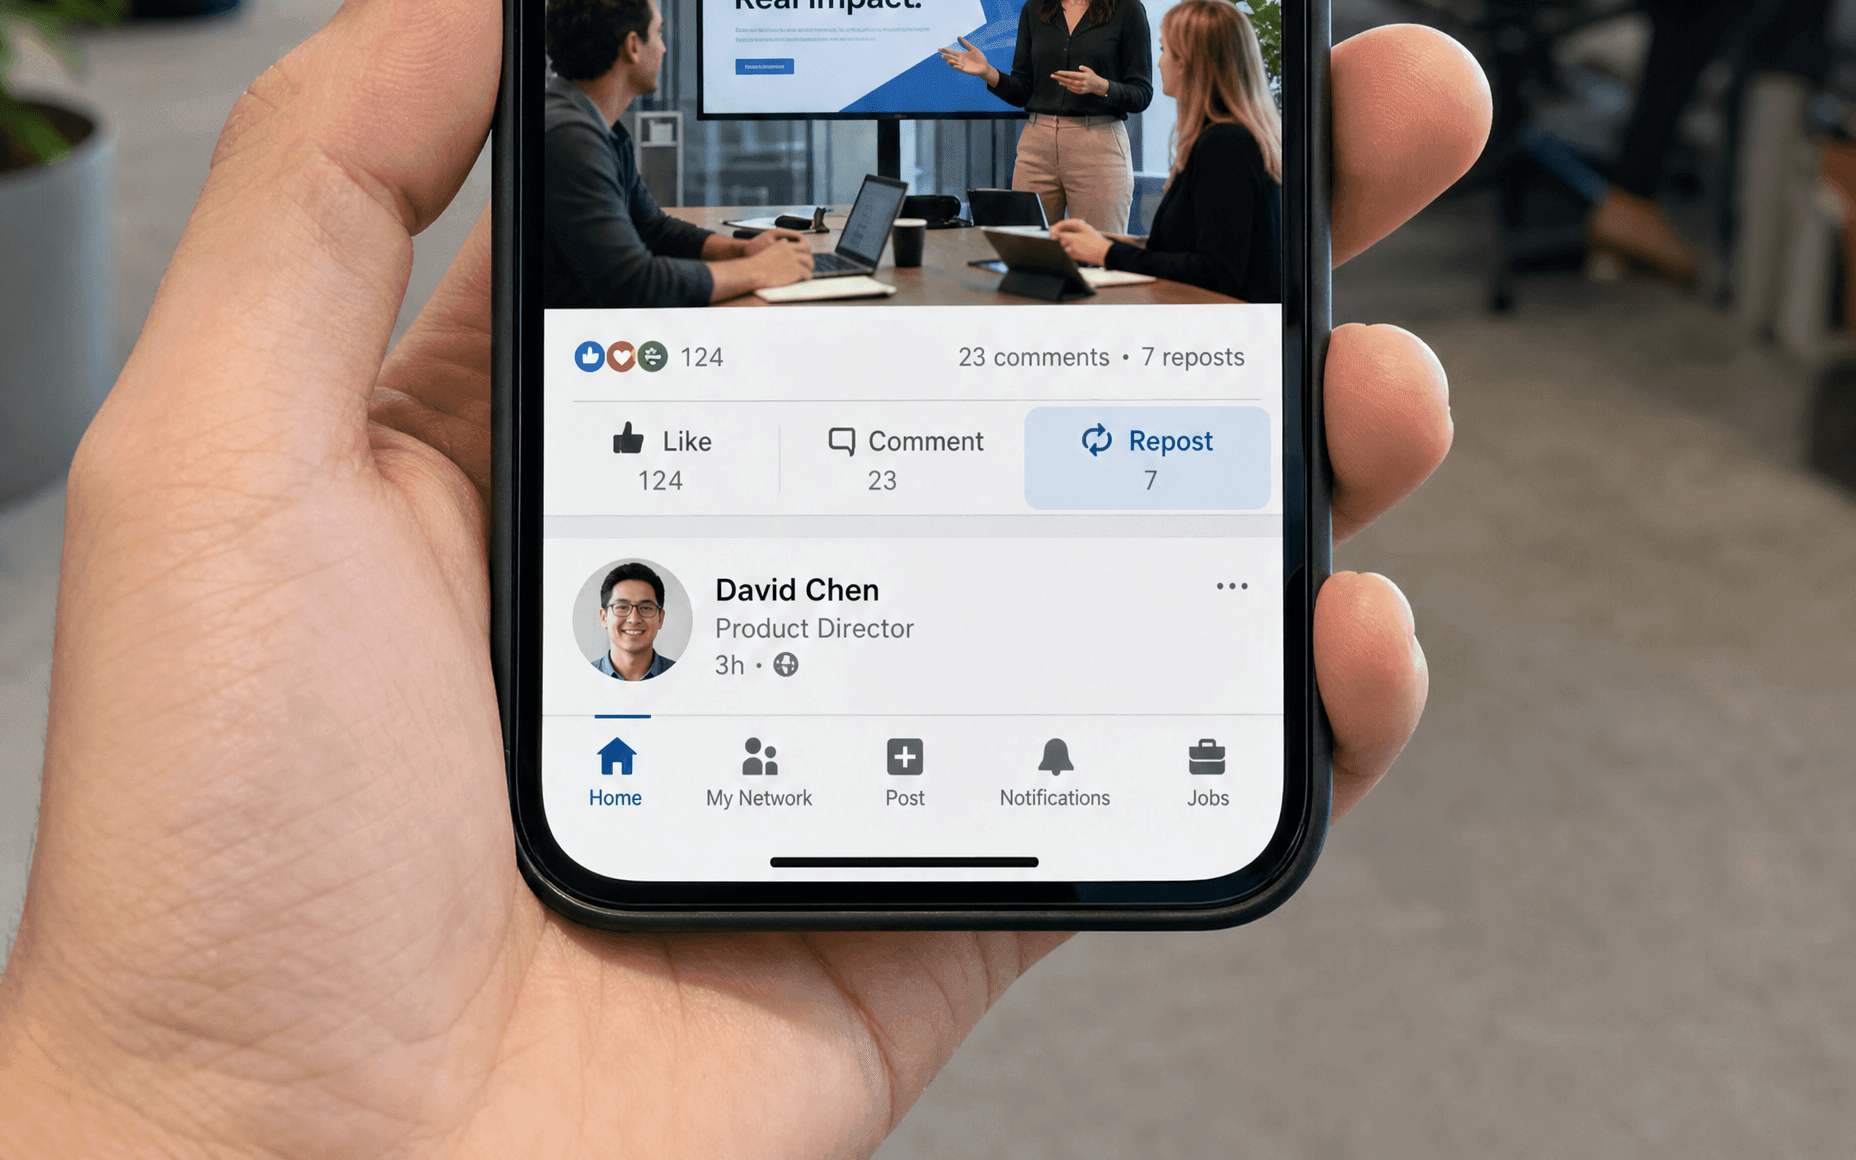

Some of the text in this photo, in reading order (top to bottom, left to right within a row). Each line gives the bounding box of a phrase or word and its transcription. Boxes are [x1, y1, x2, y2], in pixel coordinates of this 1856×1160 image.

[681, 346, 724, 367] 124
[959, 346, 1245, 372] 23 comments 7 reposts
[664, 429, 712, 452] Like
[868, 429, 985, 452] Comment
[1130, 429, 1214, 458] Repost
[638, 469, 684, 491] 124
[868, 469, 897, 491] 23
[1144, 469, 1158, 491] 7
[716, 577, 879, 602] David Chen
[716, 617, 915, 639] Product Director
[715, 653, 744, 676] 3h
[589, 788, 643, 807] Home
[706, 788, 813, 811] My Network
[886, 788, 926, 807] Post
[1000, 788, 1111, 807] Notifications
[1187, 788, 1230, 807] Jobs
